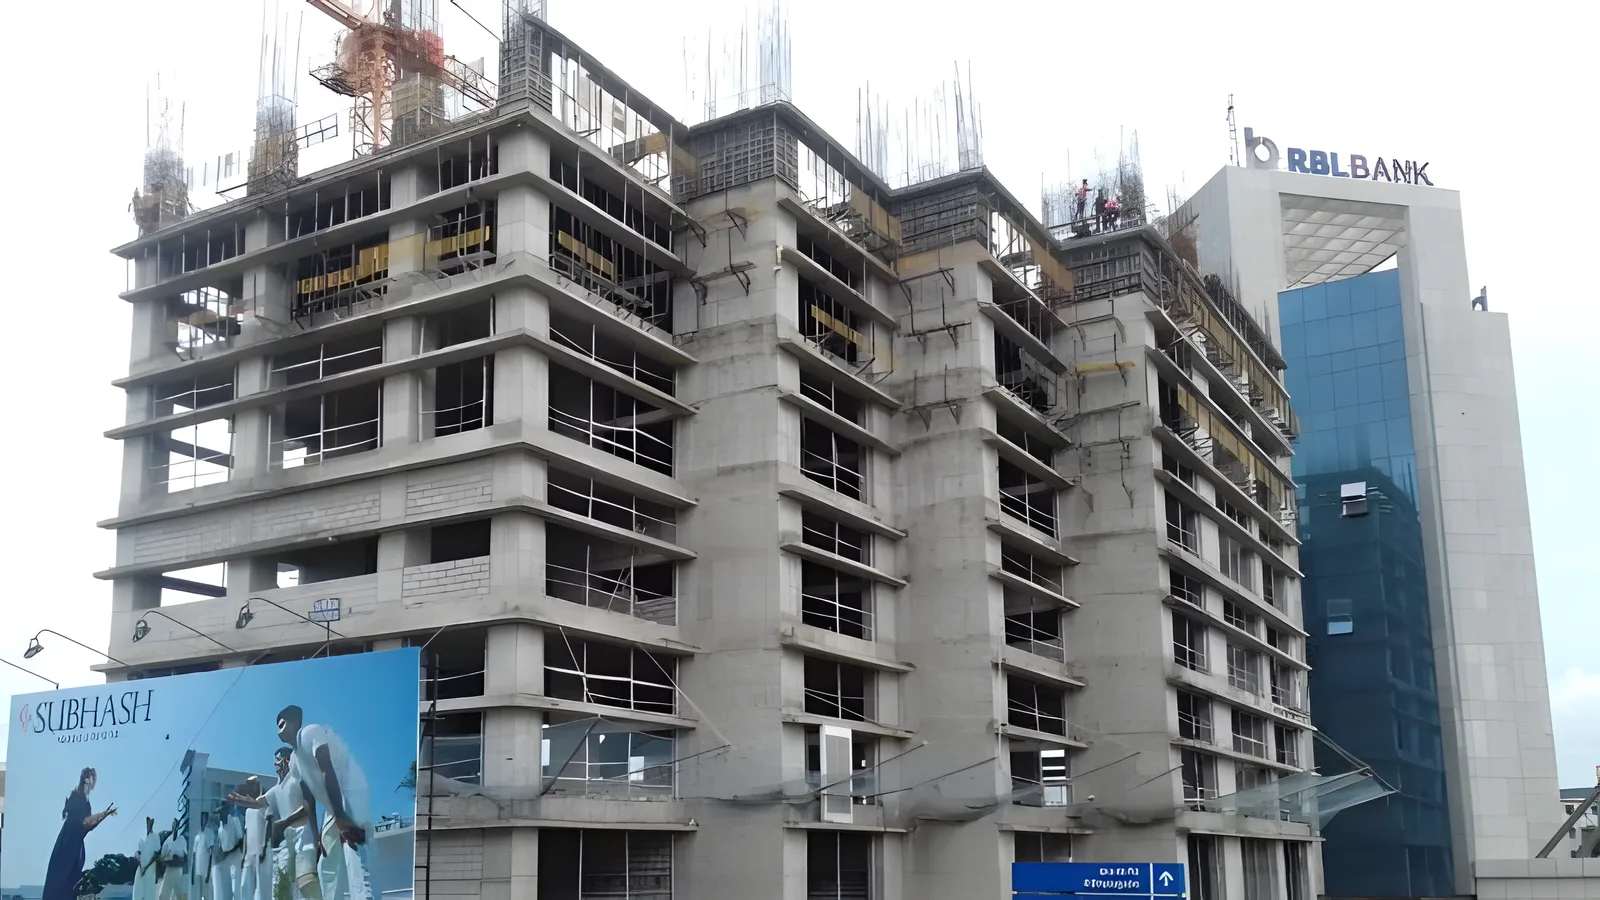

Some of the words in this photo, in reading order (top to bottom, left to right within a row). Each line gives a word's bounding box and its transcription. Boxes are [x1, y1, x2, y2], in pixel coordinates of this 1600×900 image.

[1287, 147, 1350, 178] RBL
[1350, 154, 1434, 186] BANK
[33, 689, 155, 734] SUBHASH
